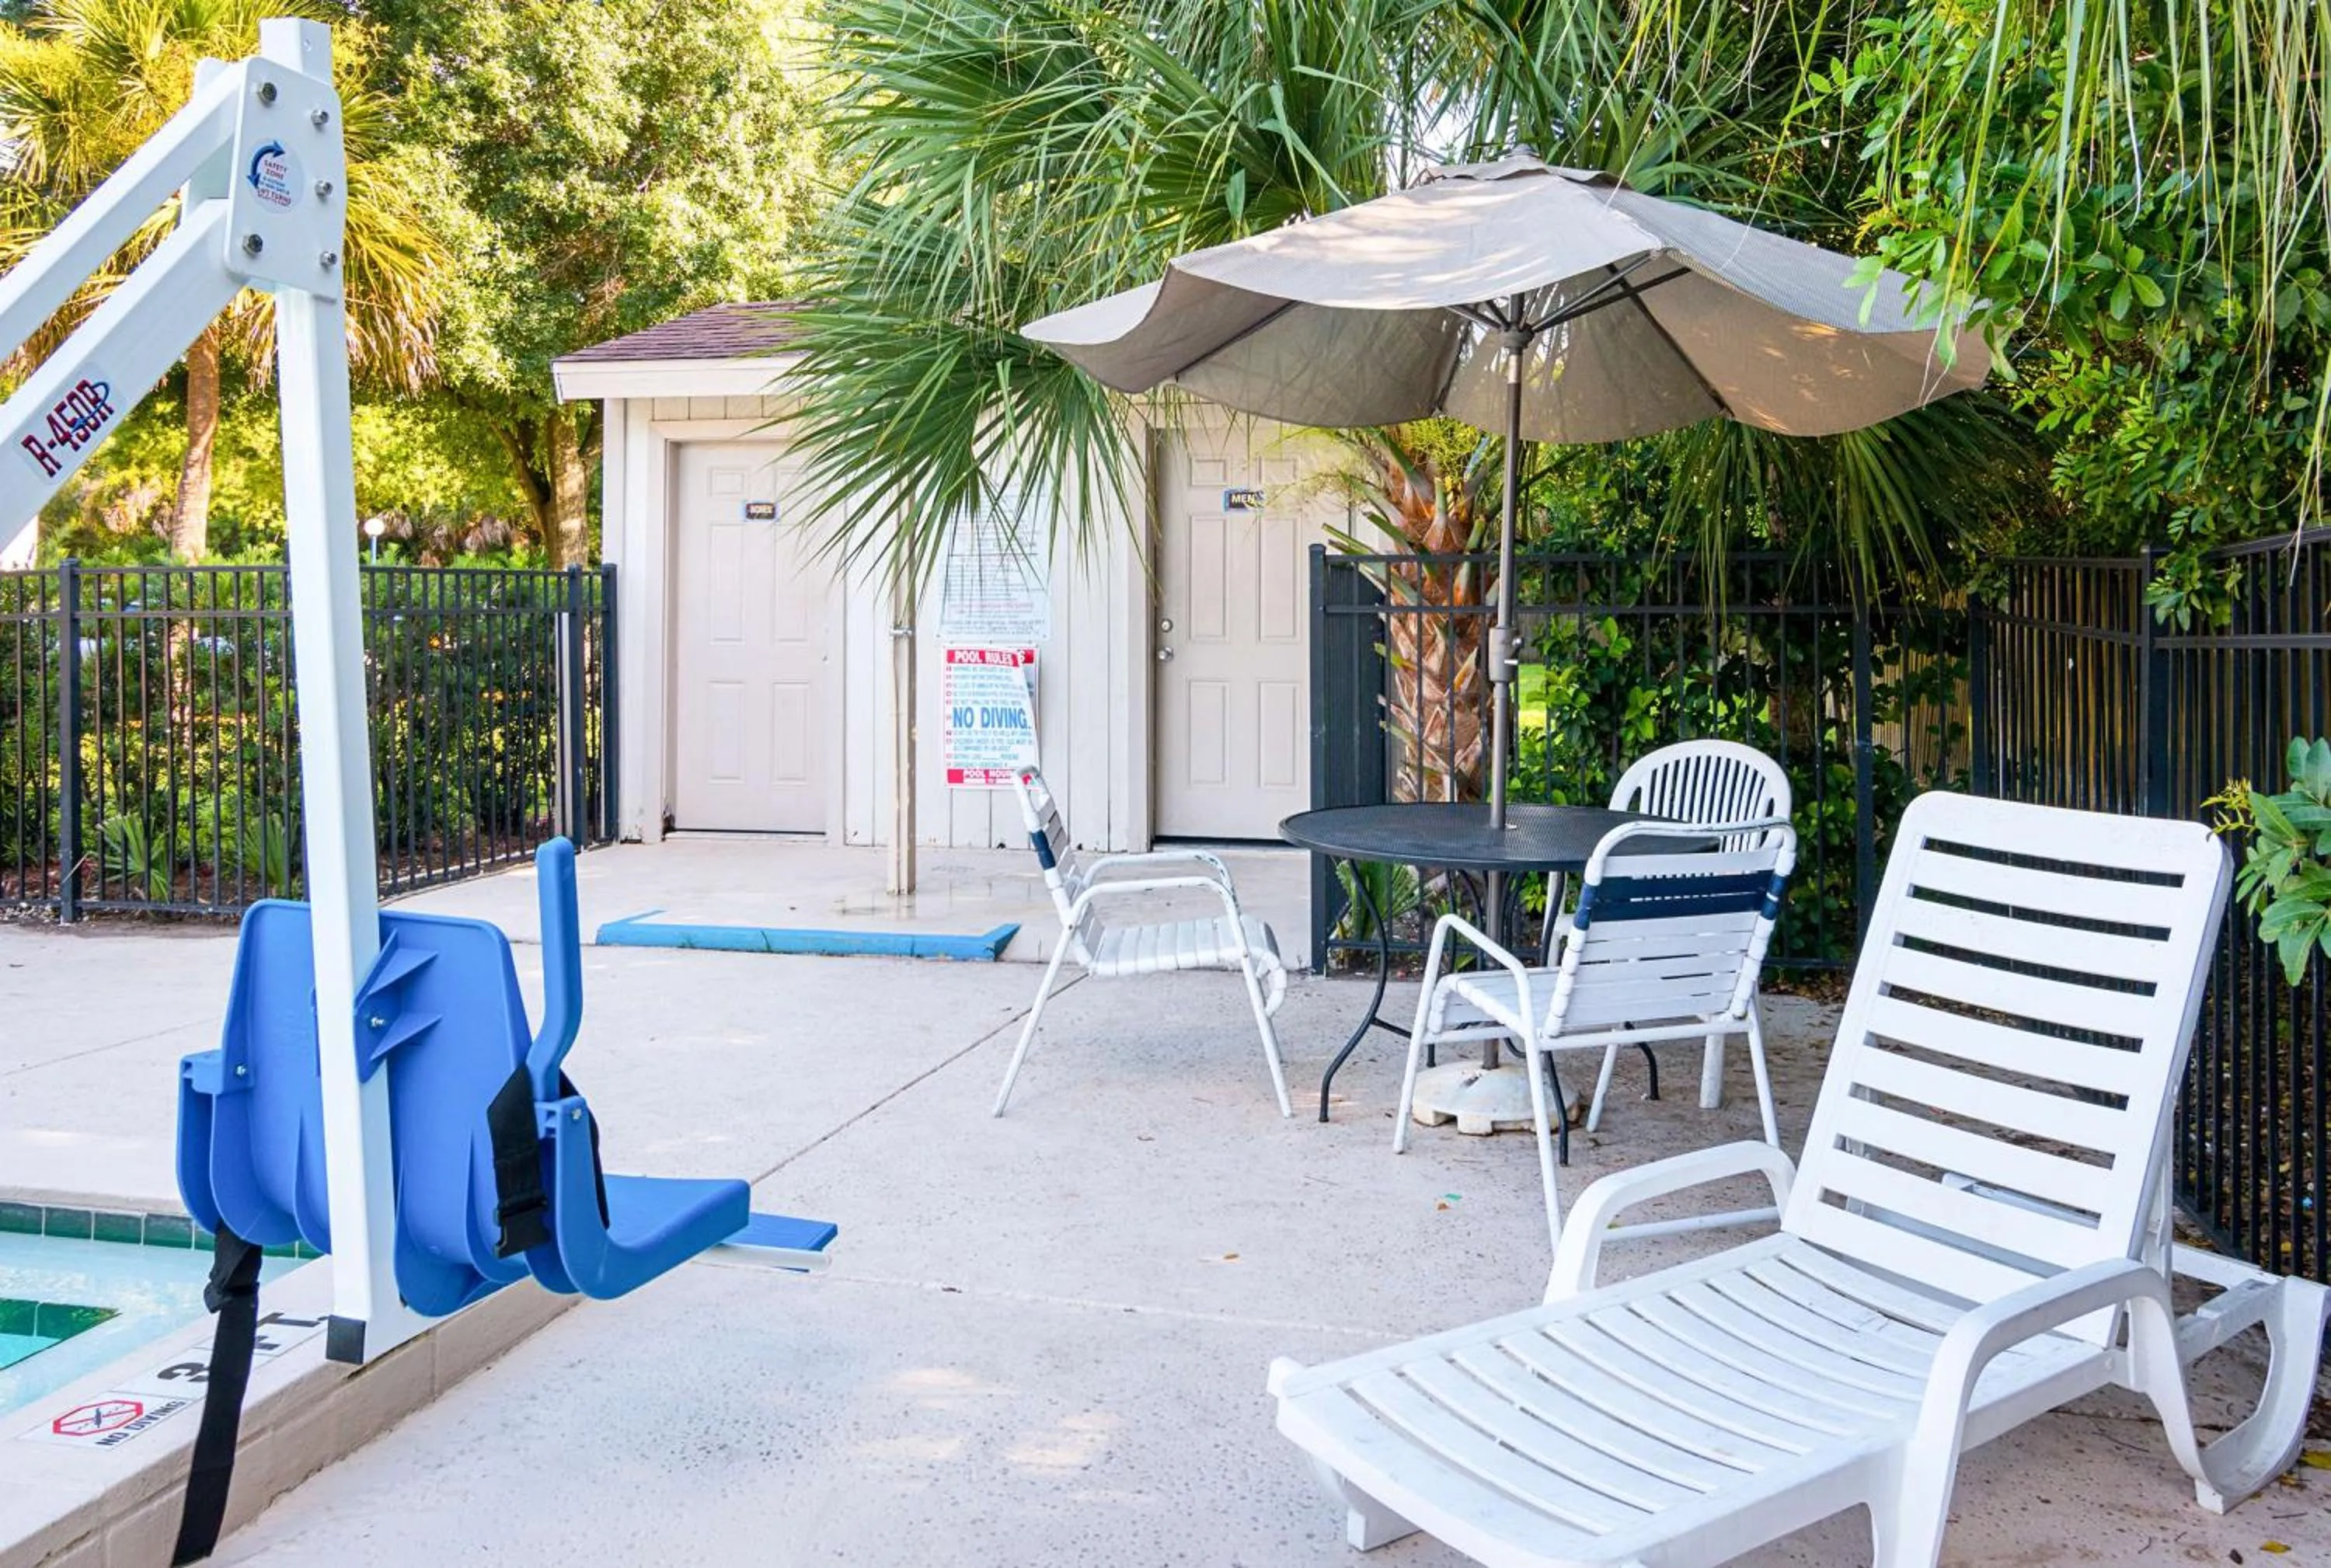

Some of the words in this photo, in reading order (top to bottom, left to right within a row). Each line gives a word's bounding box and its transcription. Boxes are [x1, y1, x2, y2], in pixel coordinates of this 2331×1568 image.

[20, 378, 115, 478] R-450R
[955, 650, 981, 663] POOL
[953, 706, 974, 729] NO
[94, 1432, 130, 1446] NO
